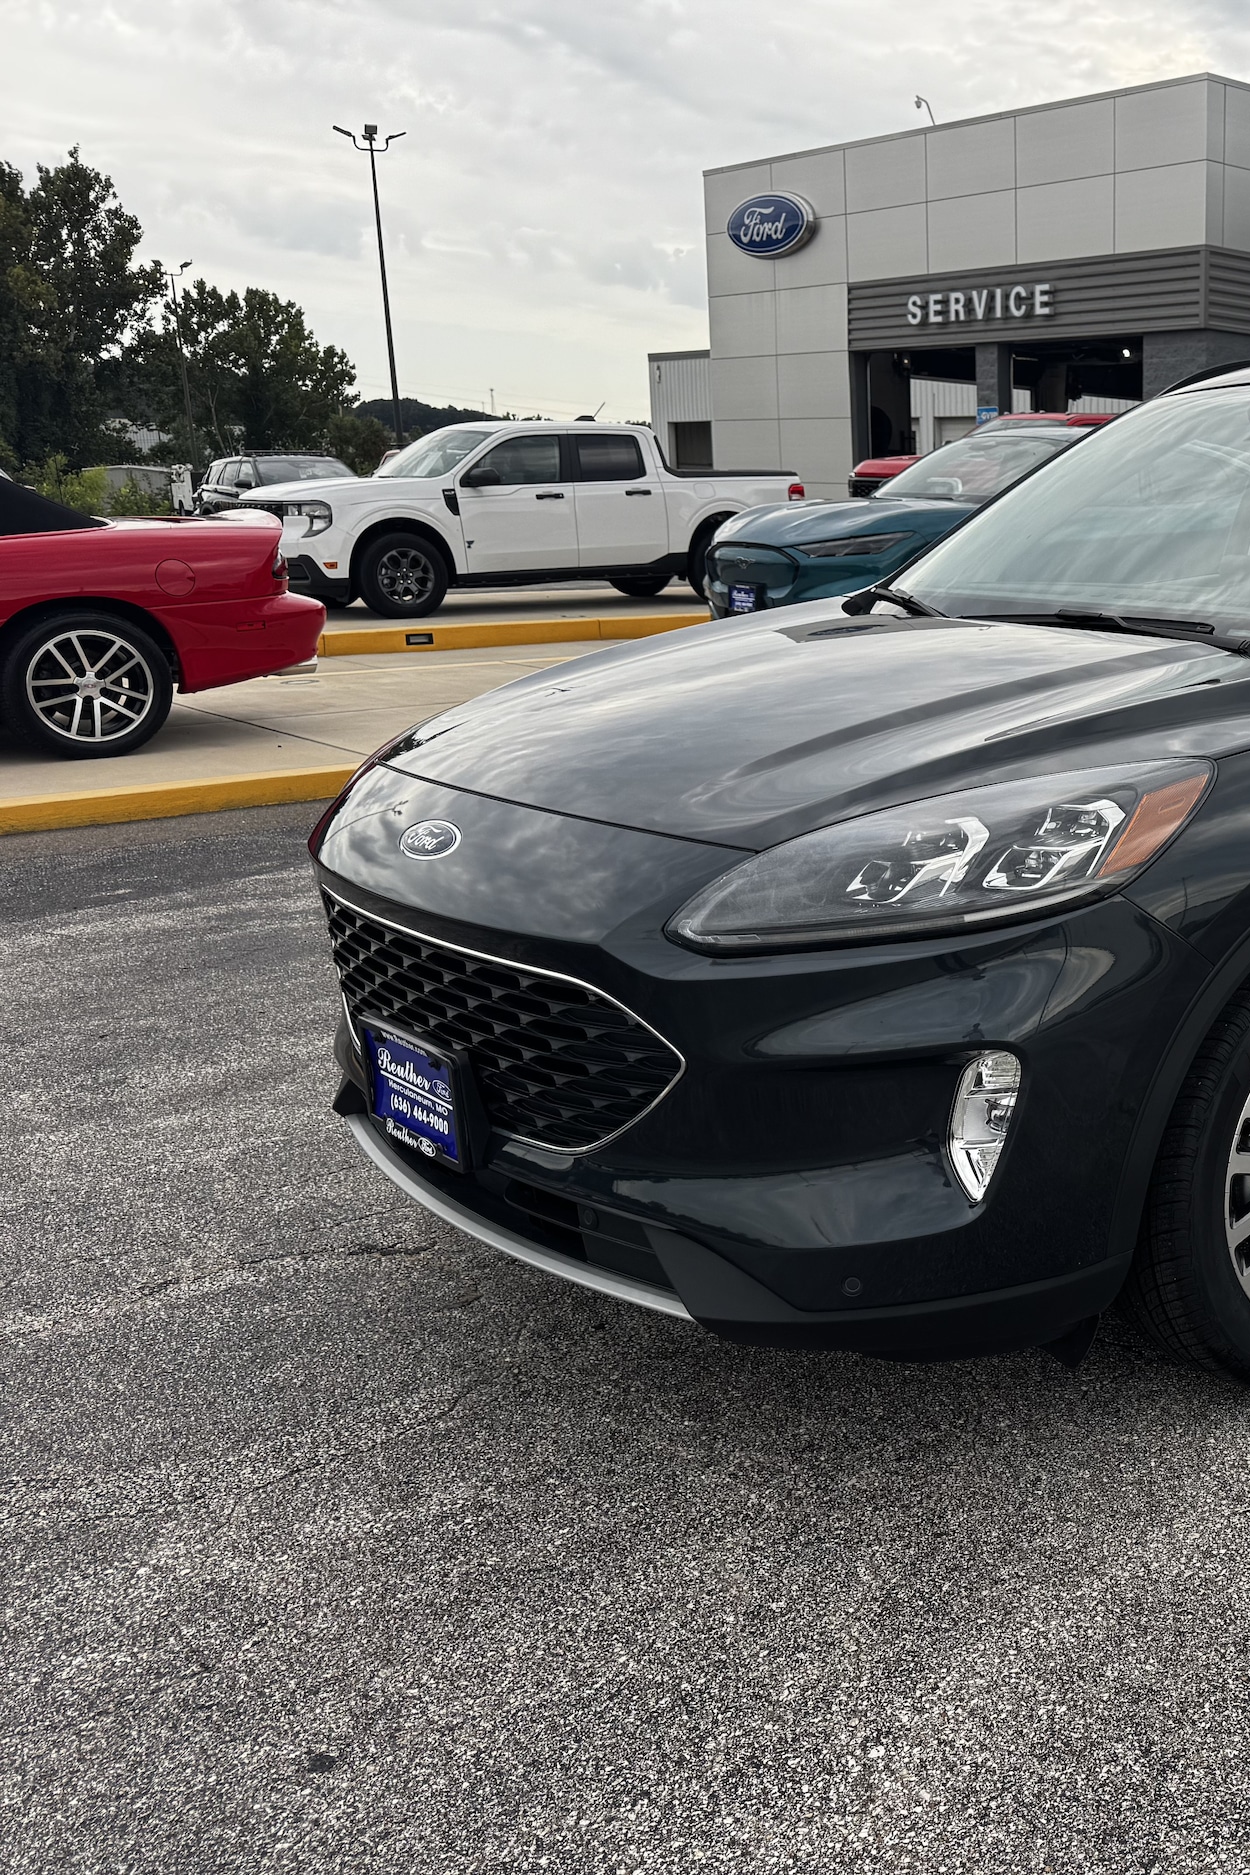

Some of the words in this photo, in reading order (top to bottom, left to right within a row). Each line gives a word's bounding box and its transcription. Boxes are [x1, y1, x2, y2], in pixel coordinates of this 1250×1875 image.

[740, 206, 786, 243] Ford
[907, 283, 1053, 325] SERVICE
[407, 825, 445, 850] Ford
[377, 1047, 432, 1091] Reuther
[390, 1093, 411, 1118] (636)
[413, 1105, 449, 1135] 464-9000
[436, 1104, 448, 1116] MO
[385, 1117, 418, 1149] Reuther
